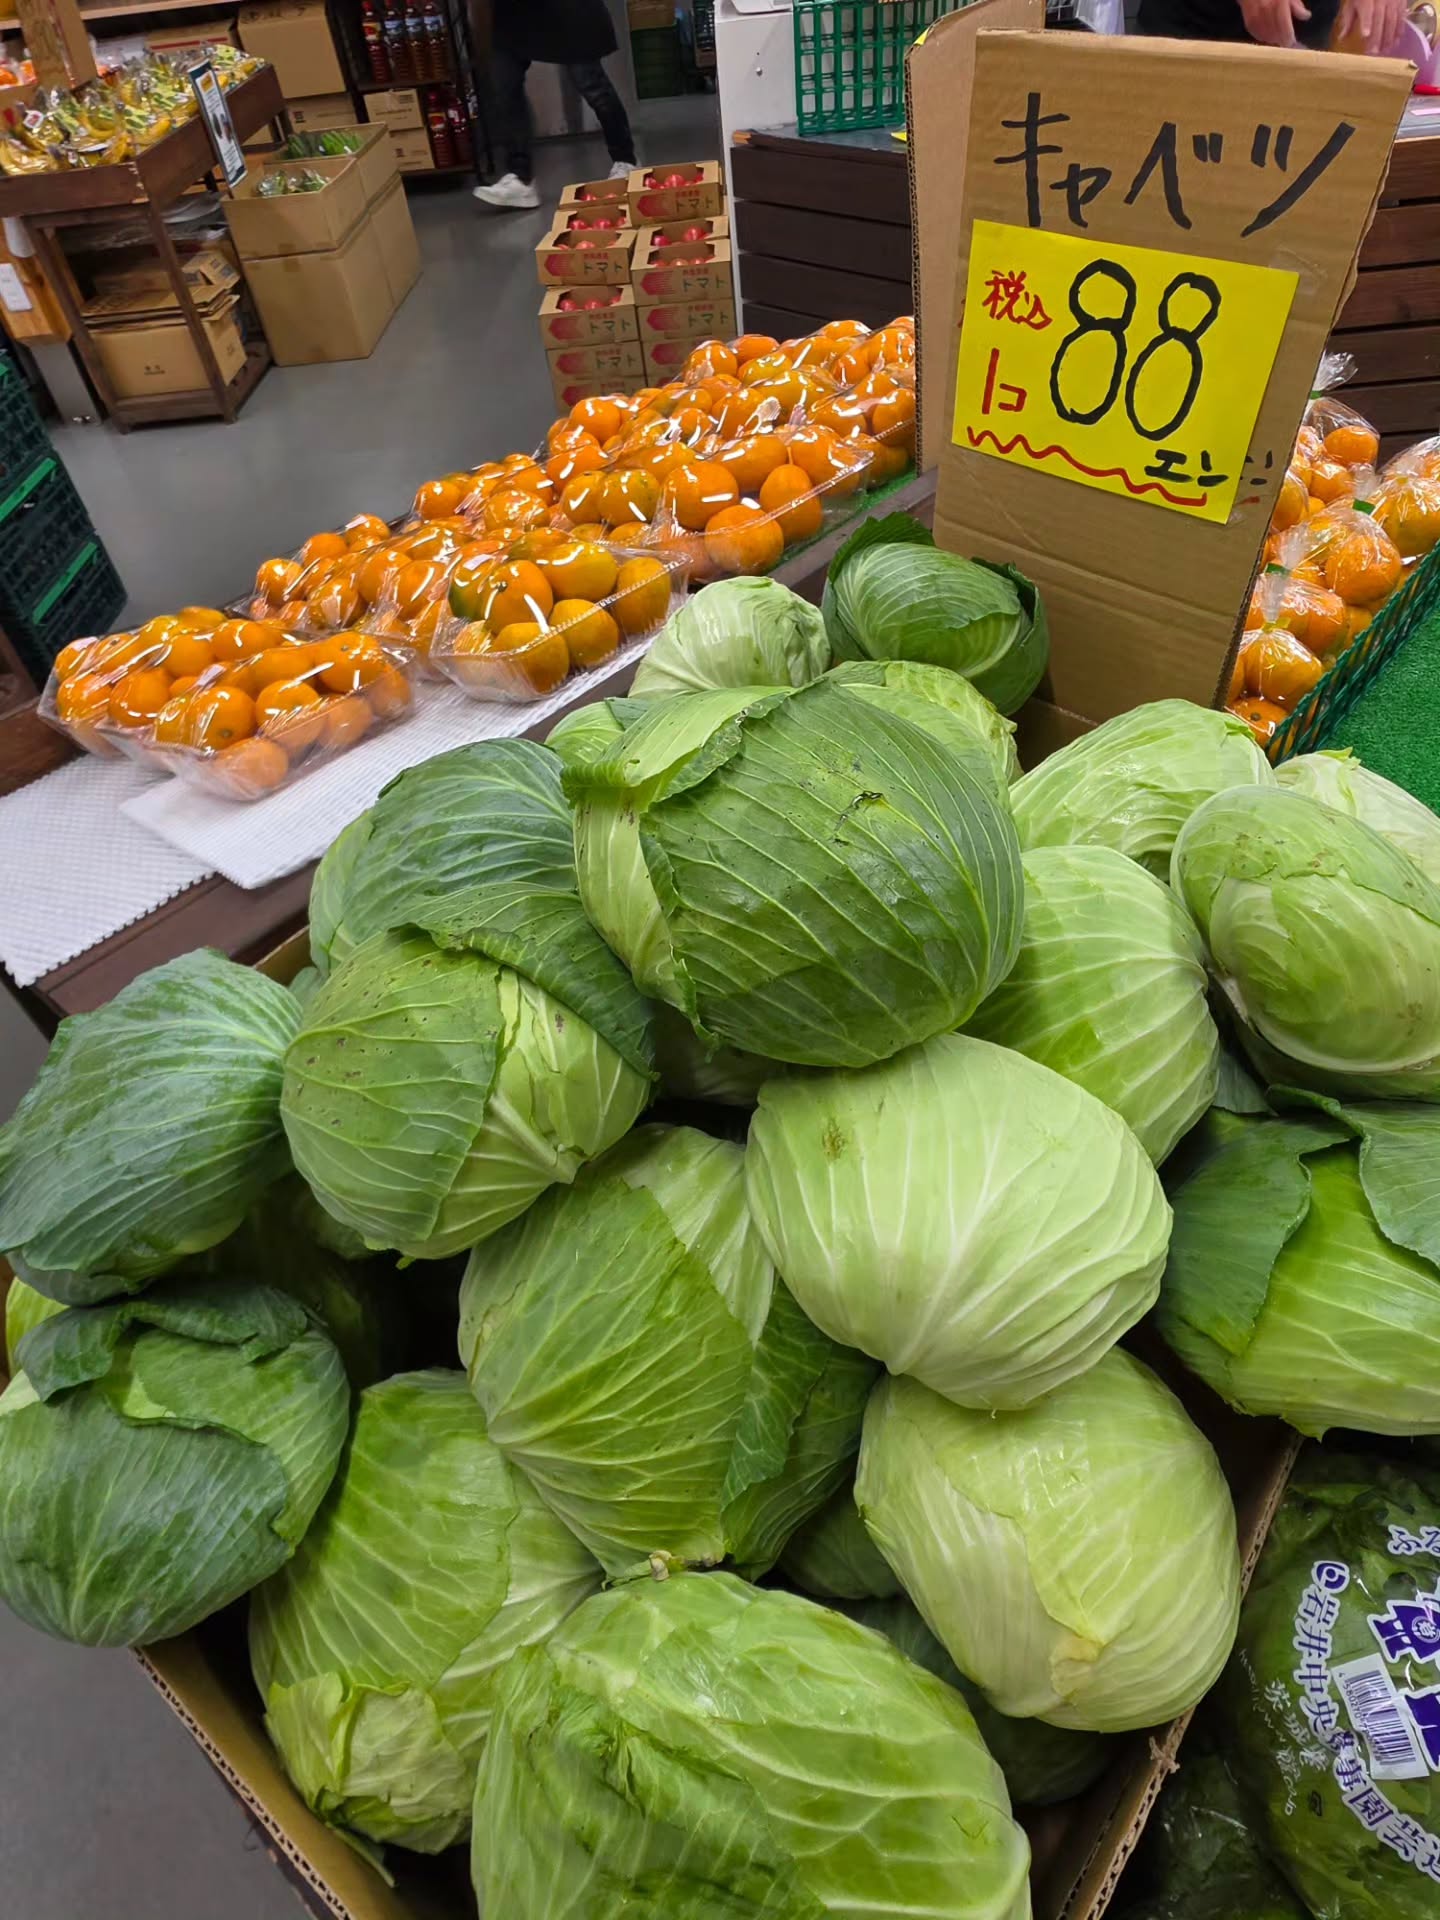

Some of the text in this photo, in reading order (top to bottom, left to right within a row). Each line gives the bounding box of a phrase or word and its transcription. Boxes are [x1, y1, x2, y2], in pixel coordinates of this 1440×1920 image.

[994, 92, 1355, 237] キャベツ
[584, 261, 623, 275] トマト
[683, 276, 728, 293] トマト
[982, 271, 1052, 330] 税込
[1050, 258, 1222, 441] 88
[1145, 449, 1229, 487] エン
